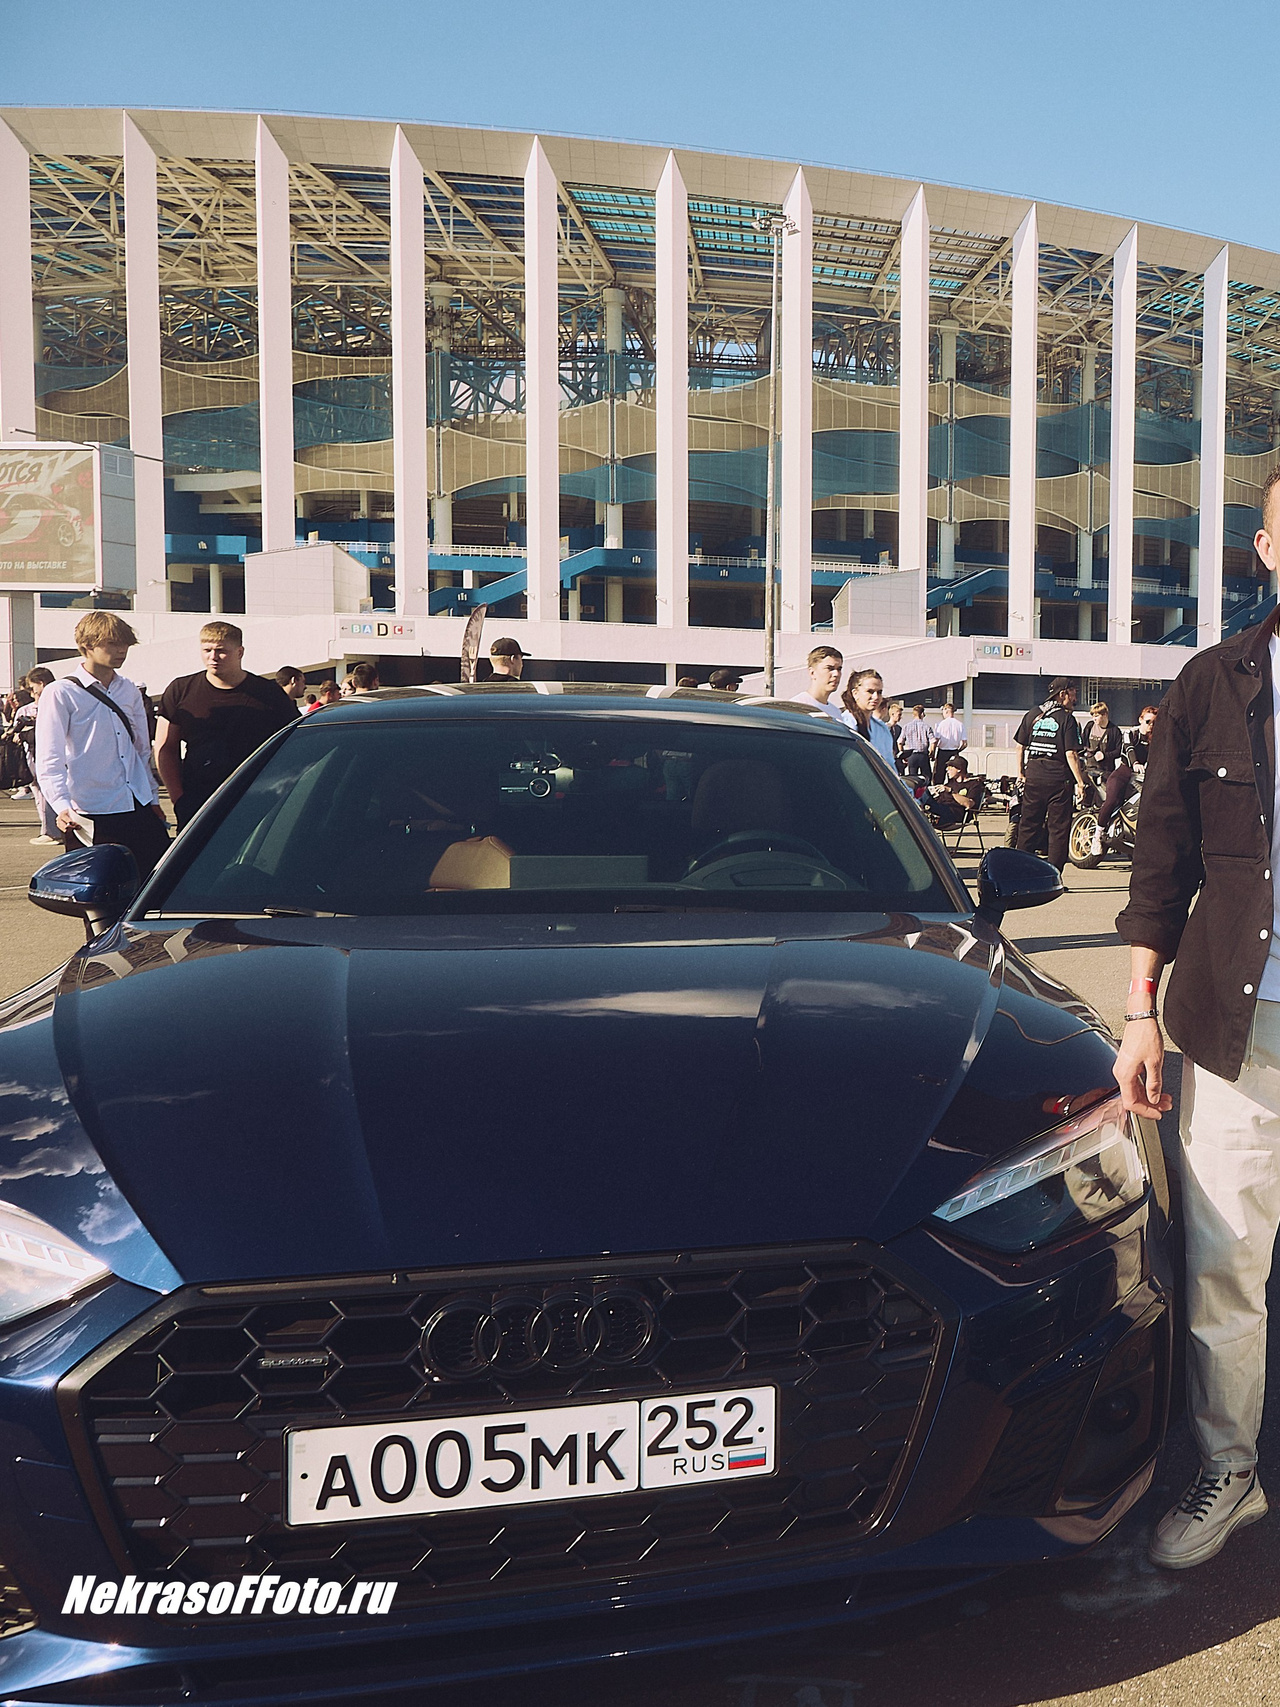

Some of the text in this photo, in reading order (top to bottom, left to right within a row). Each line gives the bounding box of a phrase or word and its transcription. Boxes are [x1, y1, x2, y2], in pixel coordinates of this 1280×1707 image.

[14, 561, 25, 570] НА
[27, 560, 68, 570] ВЫСТАВКЕ
[315, 1397, 755, 1511] А005МК 252
[673, 1452, 725, 1476] RUS
